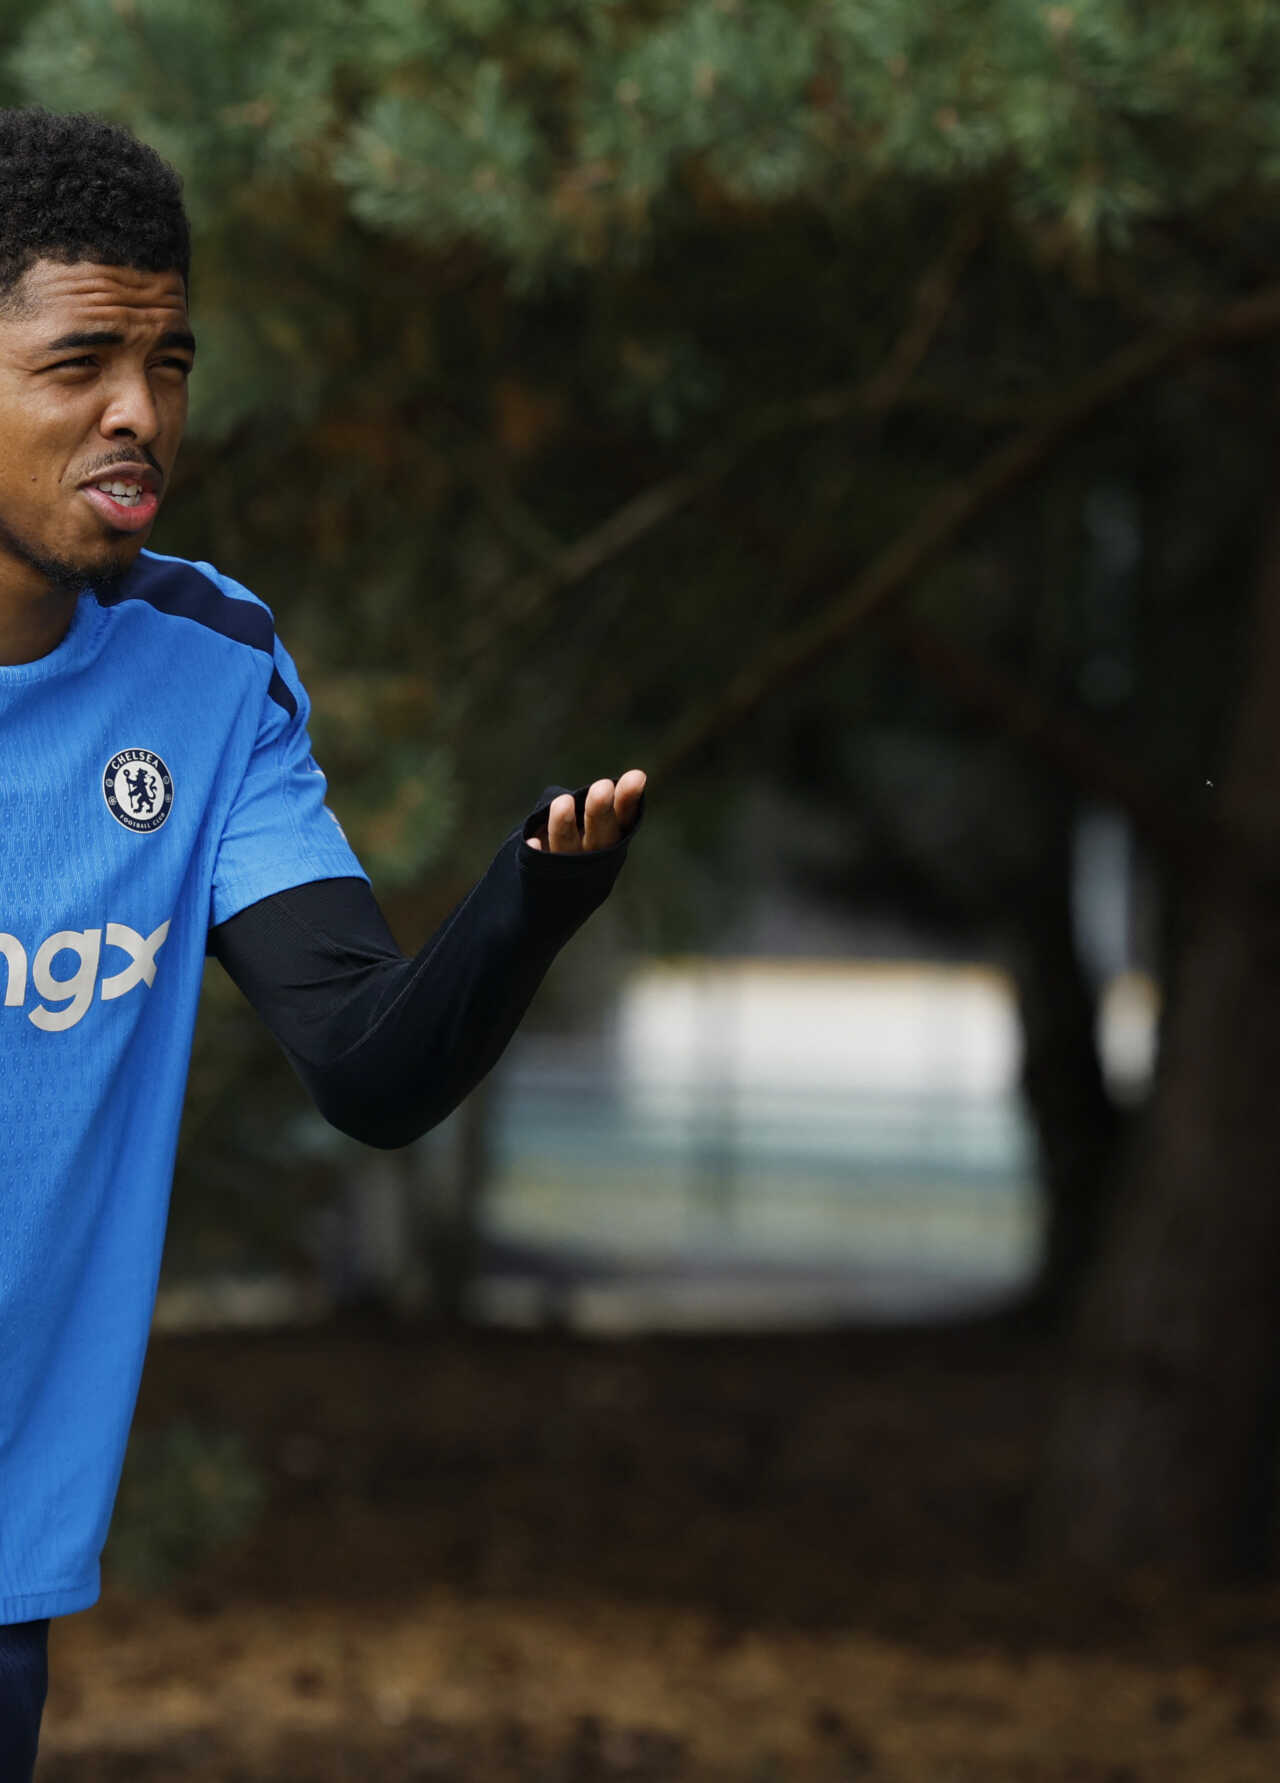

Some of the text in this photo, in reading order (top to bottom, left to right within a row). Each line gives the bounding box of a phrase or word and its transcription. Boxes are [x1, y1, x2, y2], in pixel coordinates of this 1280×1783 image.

[112, 752, 159, 769] CHELSEA
[120, 812, 166, 829] FOOTBALL CLUB
